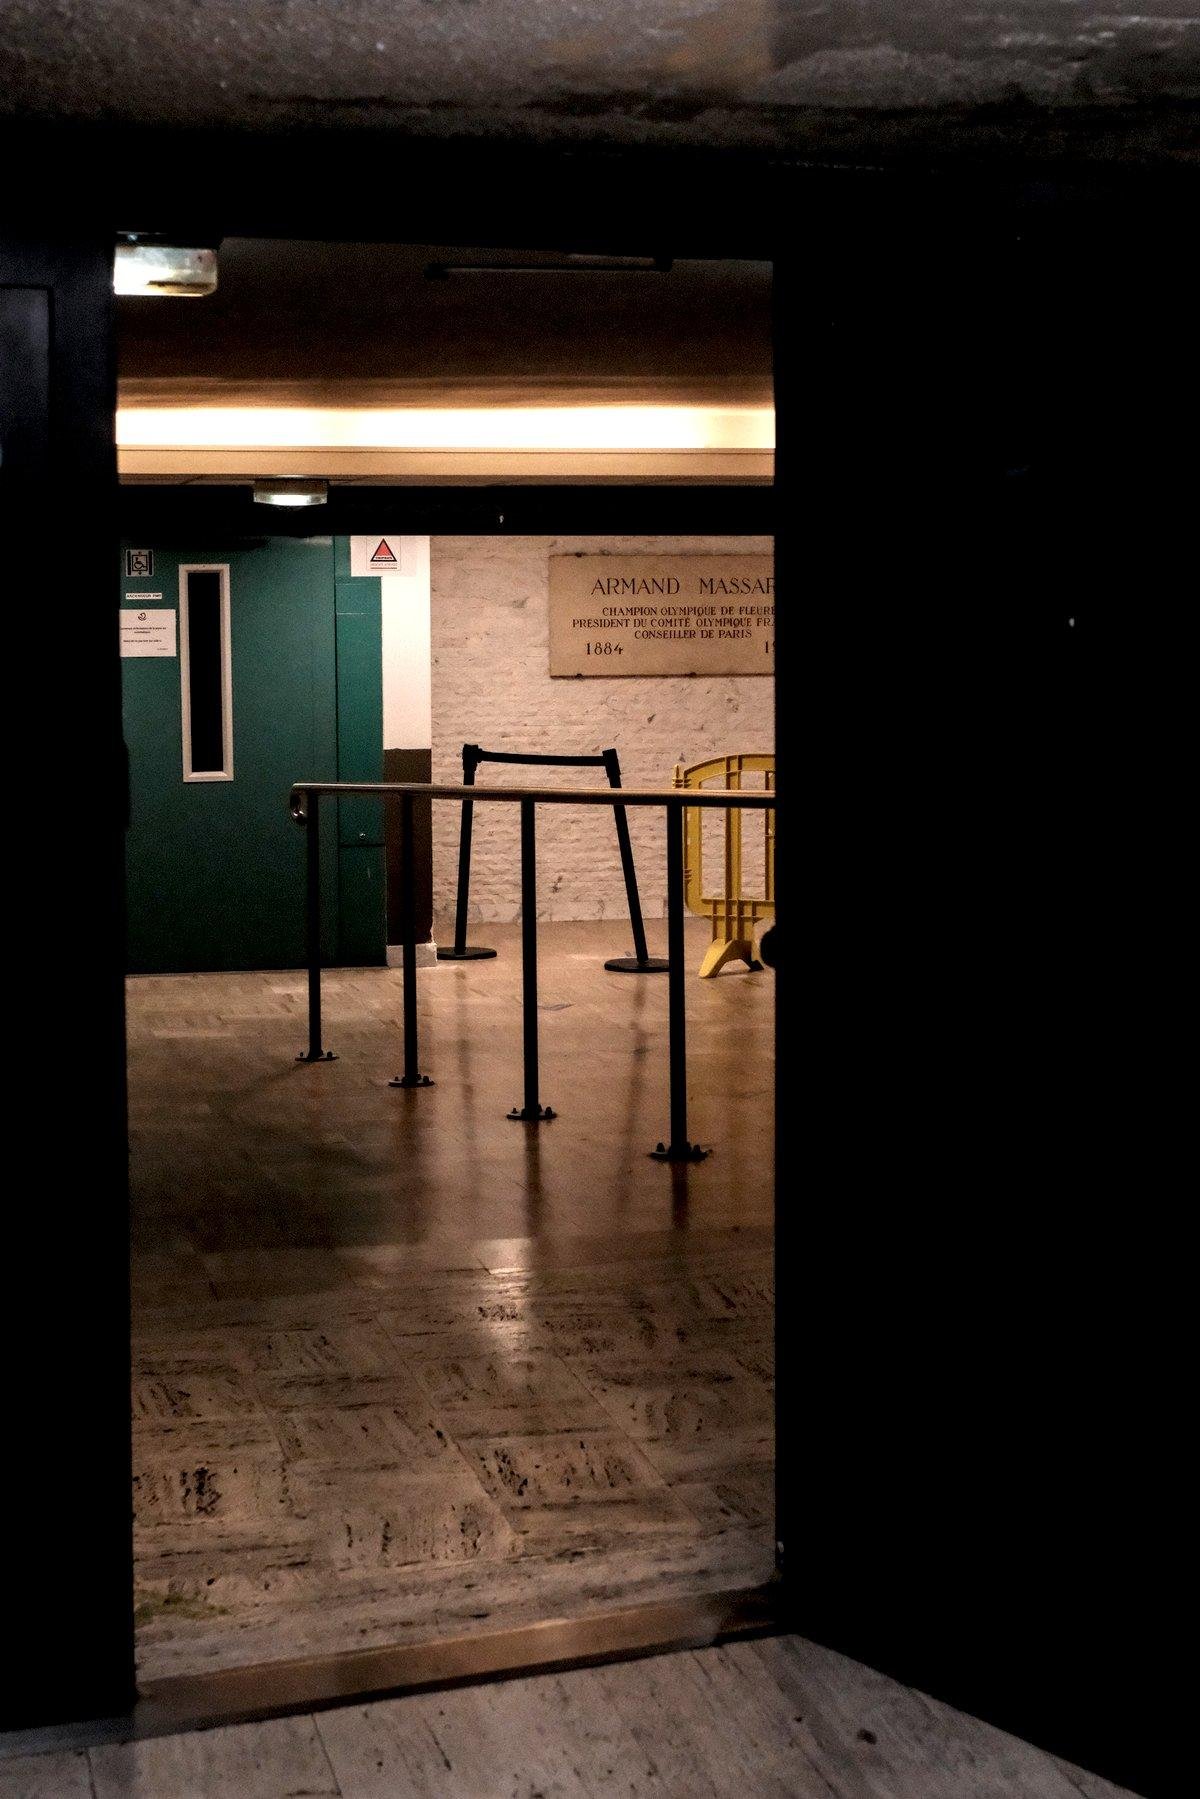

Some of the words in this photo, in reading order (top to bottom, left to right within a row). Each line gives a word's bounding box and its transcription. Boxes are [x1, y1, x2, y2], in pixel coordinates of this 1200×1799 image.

[591, 577, 680, 595] ARMAND
[602, 606, 658, 616] CHAMPION
[660, 606, 717, 617] OLYMPIQUE
[721, 606, 734, 616] DE
[633, 618, 647, 628] DU
[696, 618, 752, 629] OLYMPIQUE
[634, 629, 697, 640] CONSEILLER
[701, 629, 714, 640] DE
[718, 629, 752, 640] PARIS
[585, 642, 624, 656] 1884
